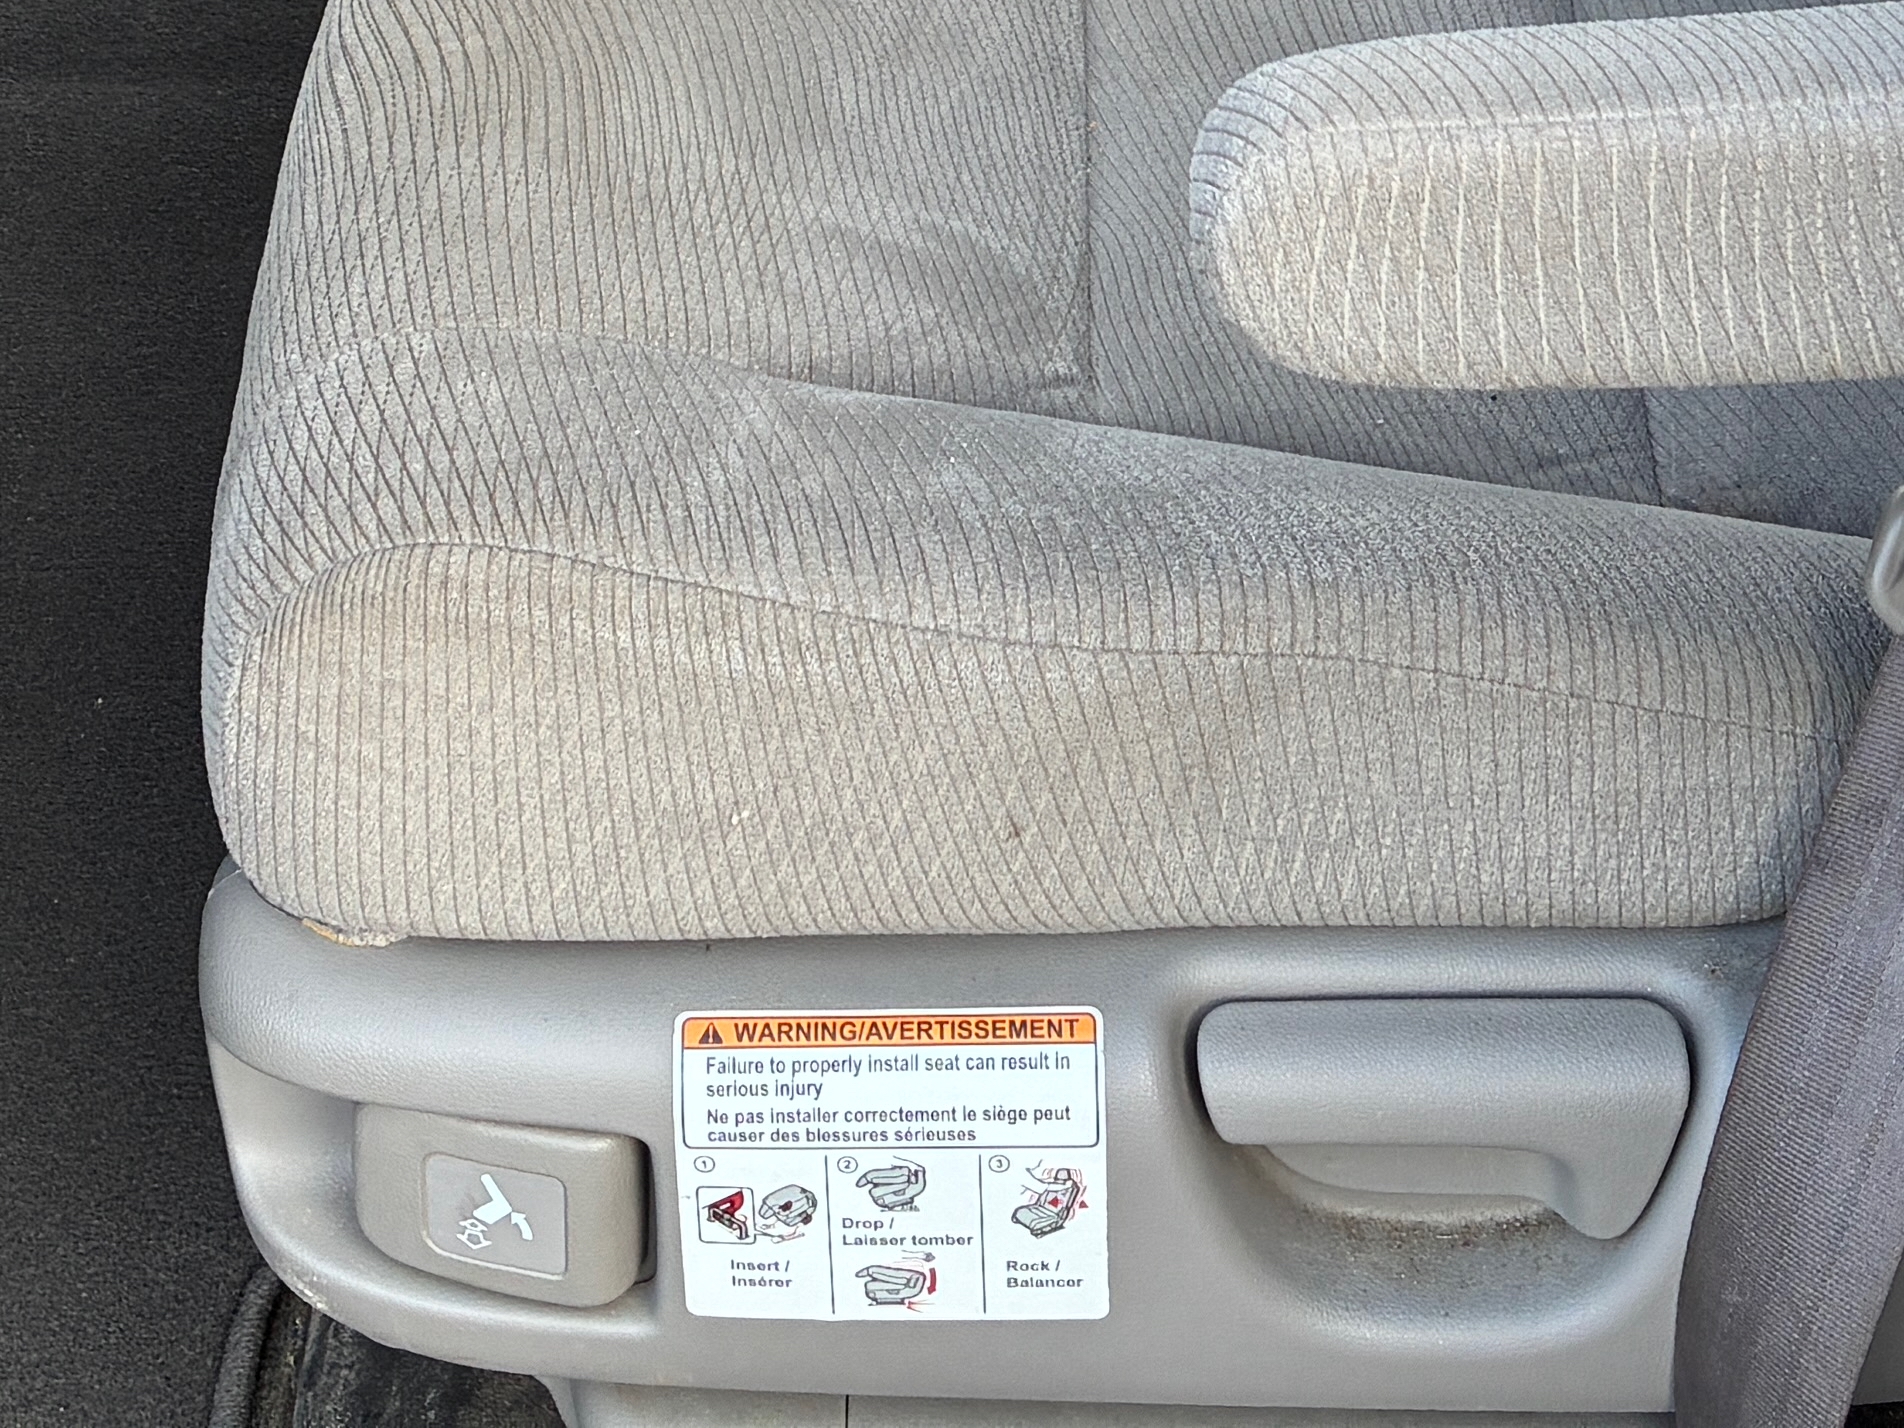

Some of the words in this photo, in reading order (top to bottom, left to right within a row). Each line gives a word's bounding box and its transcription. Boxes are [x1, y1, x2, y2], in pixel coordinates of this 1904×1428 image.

[733, 1018, 1080, 1043] WARNING/AVERTISSEMENT
[706, 1056, 764, 1075] Failure
[770, 1056, 786, 1074] to
[791, 1054, 863, 1078] properly
[868, 1053, 919, 1073] install
[924, 1054, 961, 1072] seat
[965, 1056, 995, 1071] can
[1001, 1051, 1050, 1071] result
[1055, 1050, 1071, 1070] in
[706, 1079, 769, 1098] serious
[775, 1079, 823, 1101] injury
[707, 1109, 729, 1125] Ne
[735, 1111, 765, 1128] pas
[770, 1107, 839, 1124] installer
[844, 1106, 958, 1123] correctement
[962, 1105, 977, 1122] le
[982, 1104, 1028, 1125] siège
[1033, 1105, 1071, 1126] peut
[707, 1130, 766, 1143] causer
[770, 1127, 800, 1143] des
[805, 1127, 889, 1143] blessures
[894, 1126, 977, 1142] sérieuses
[841, 1217, 884, 1232] Drop
[911, 1234, 975, 1246] tomber
[730, 1259, 780, 1271] Insert
[1006, 1260, 1051, 1272] Rock
